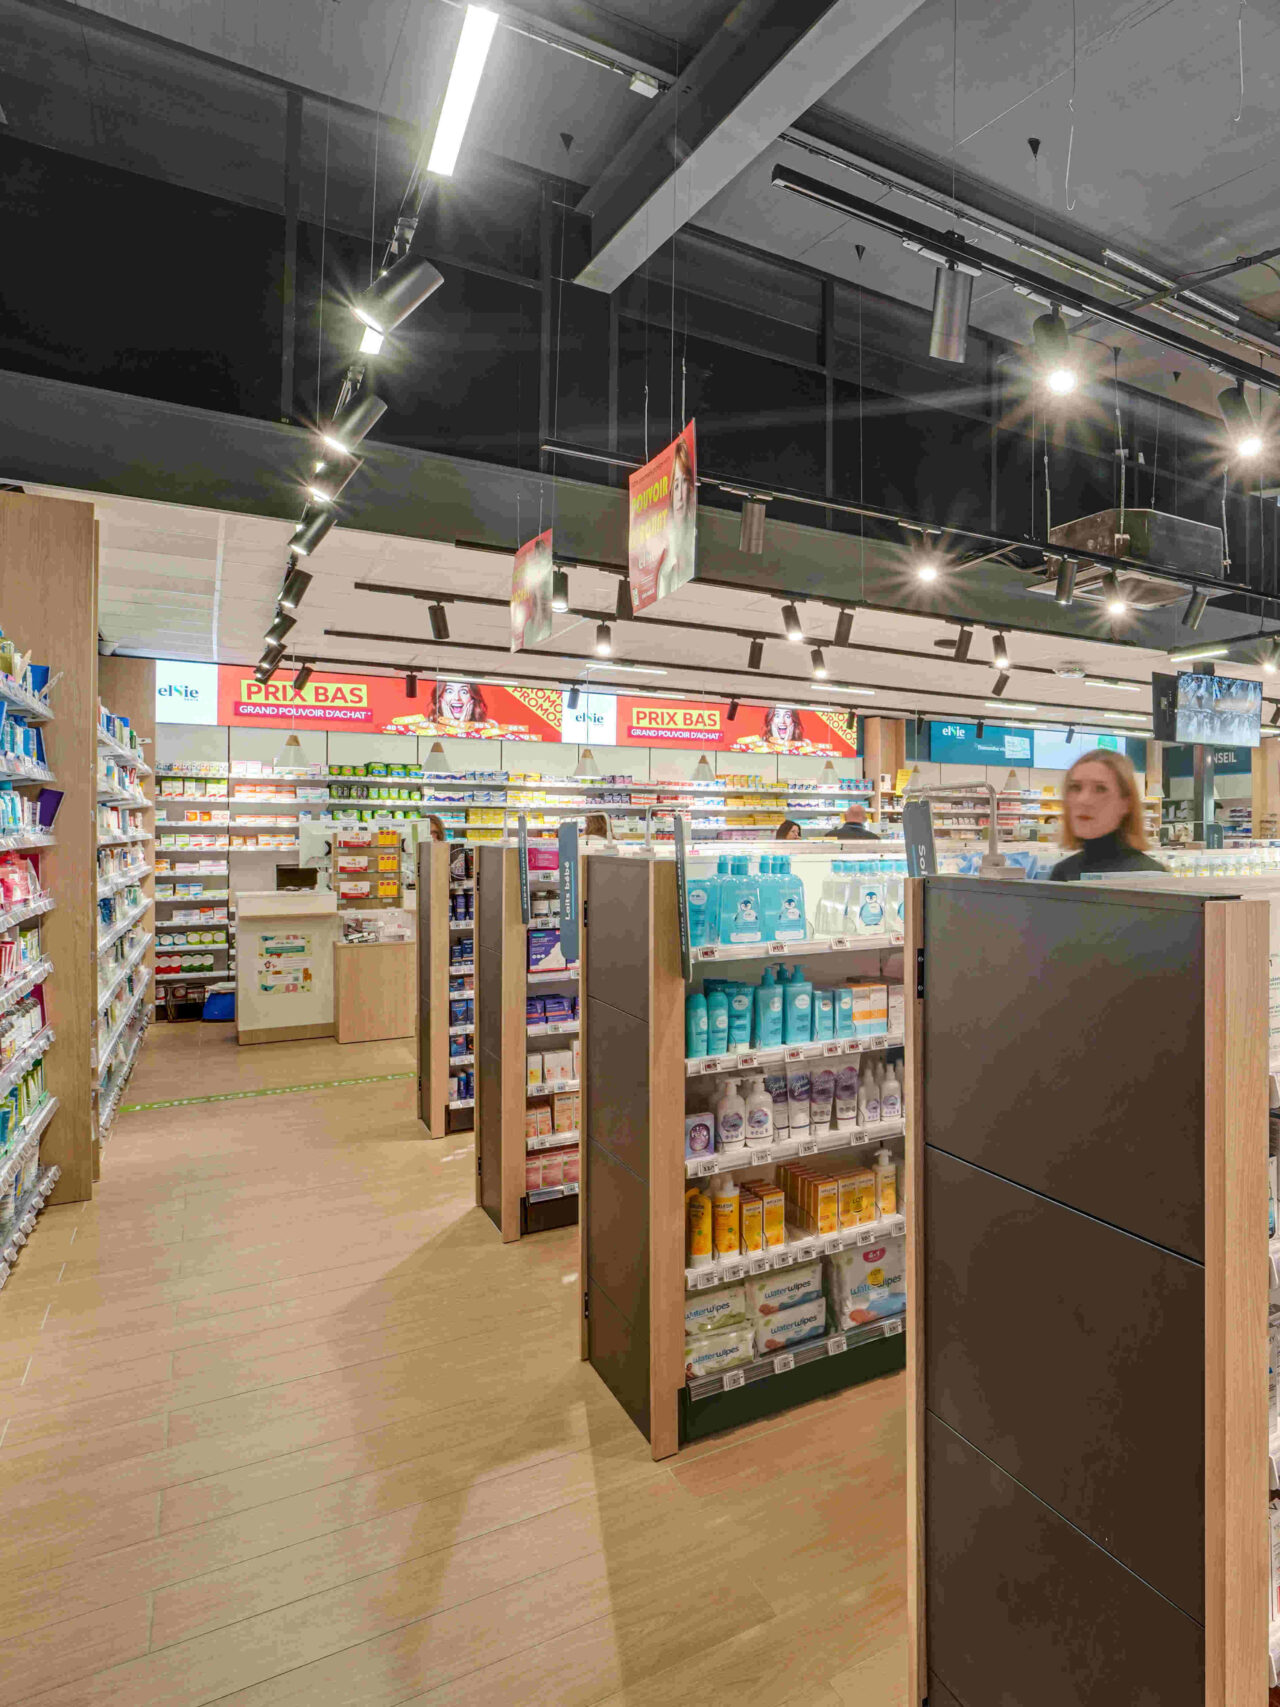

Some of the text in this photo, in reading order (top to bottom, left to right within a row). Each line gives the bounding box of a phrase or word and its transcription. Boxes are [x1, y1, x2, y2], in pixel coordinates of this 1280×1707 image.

[246, 683, 364, 704] PRIX BAS
[239, 705, 278, 715] GRAND
[278, 707, 324, 717] POUVOIR
[512, 687, 562, 728] PROMOS
[636, 711, 717, 727] PRIX BAS
[631, 729, 657, 737] GRAND
[658, 730, 690, 738] POUVOIR
[1213, 752, 1237, 763] NSEIL
